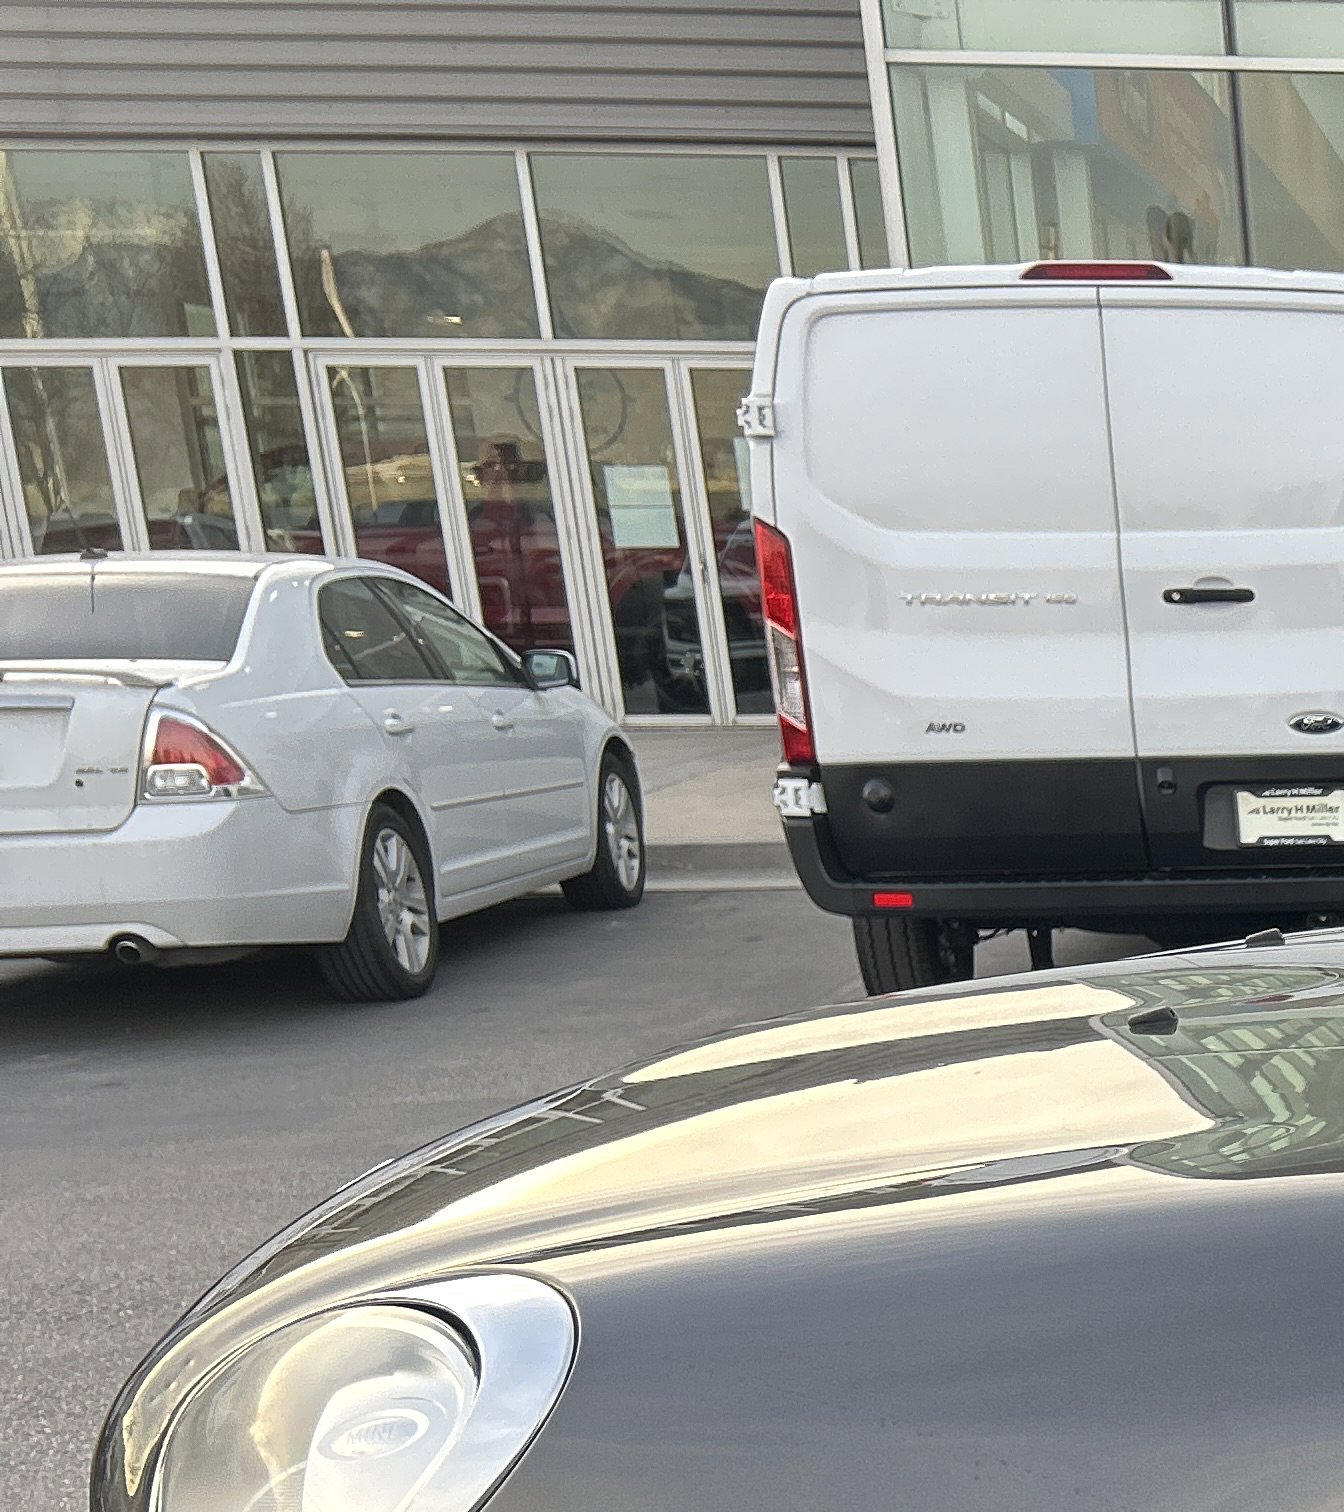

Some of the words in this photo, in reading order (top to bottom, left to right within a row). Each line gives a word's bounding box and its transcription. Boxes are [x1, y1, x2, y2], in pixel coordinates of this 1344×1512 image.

[896, 591, 1038, 606] TRANSIT
[925, 720, 966, 734] AWD
[1262, 804, 1293, 816] Larry
[1294, 804, 1304, 814] H
[1306, 803, 1340, 814] Miller
